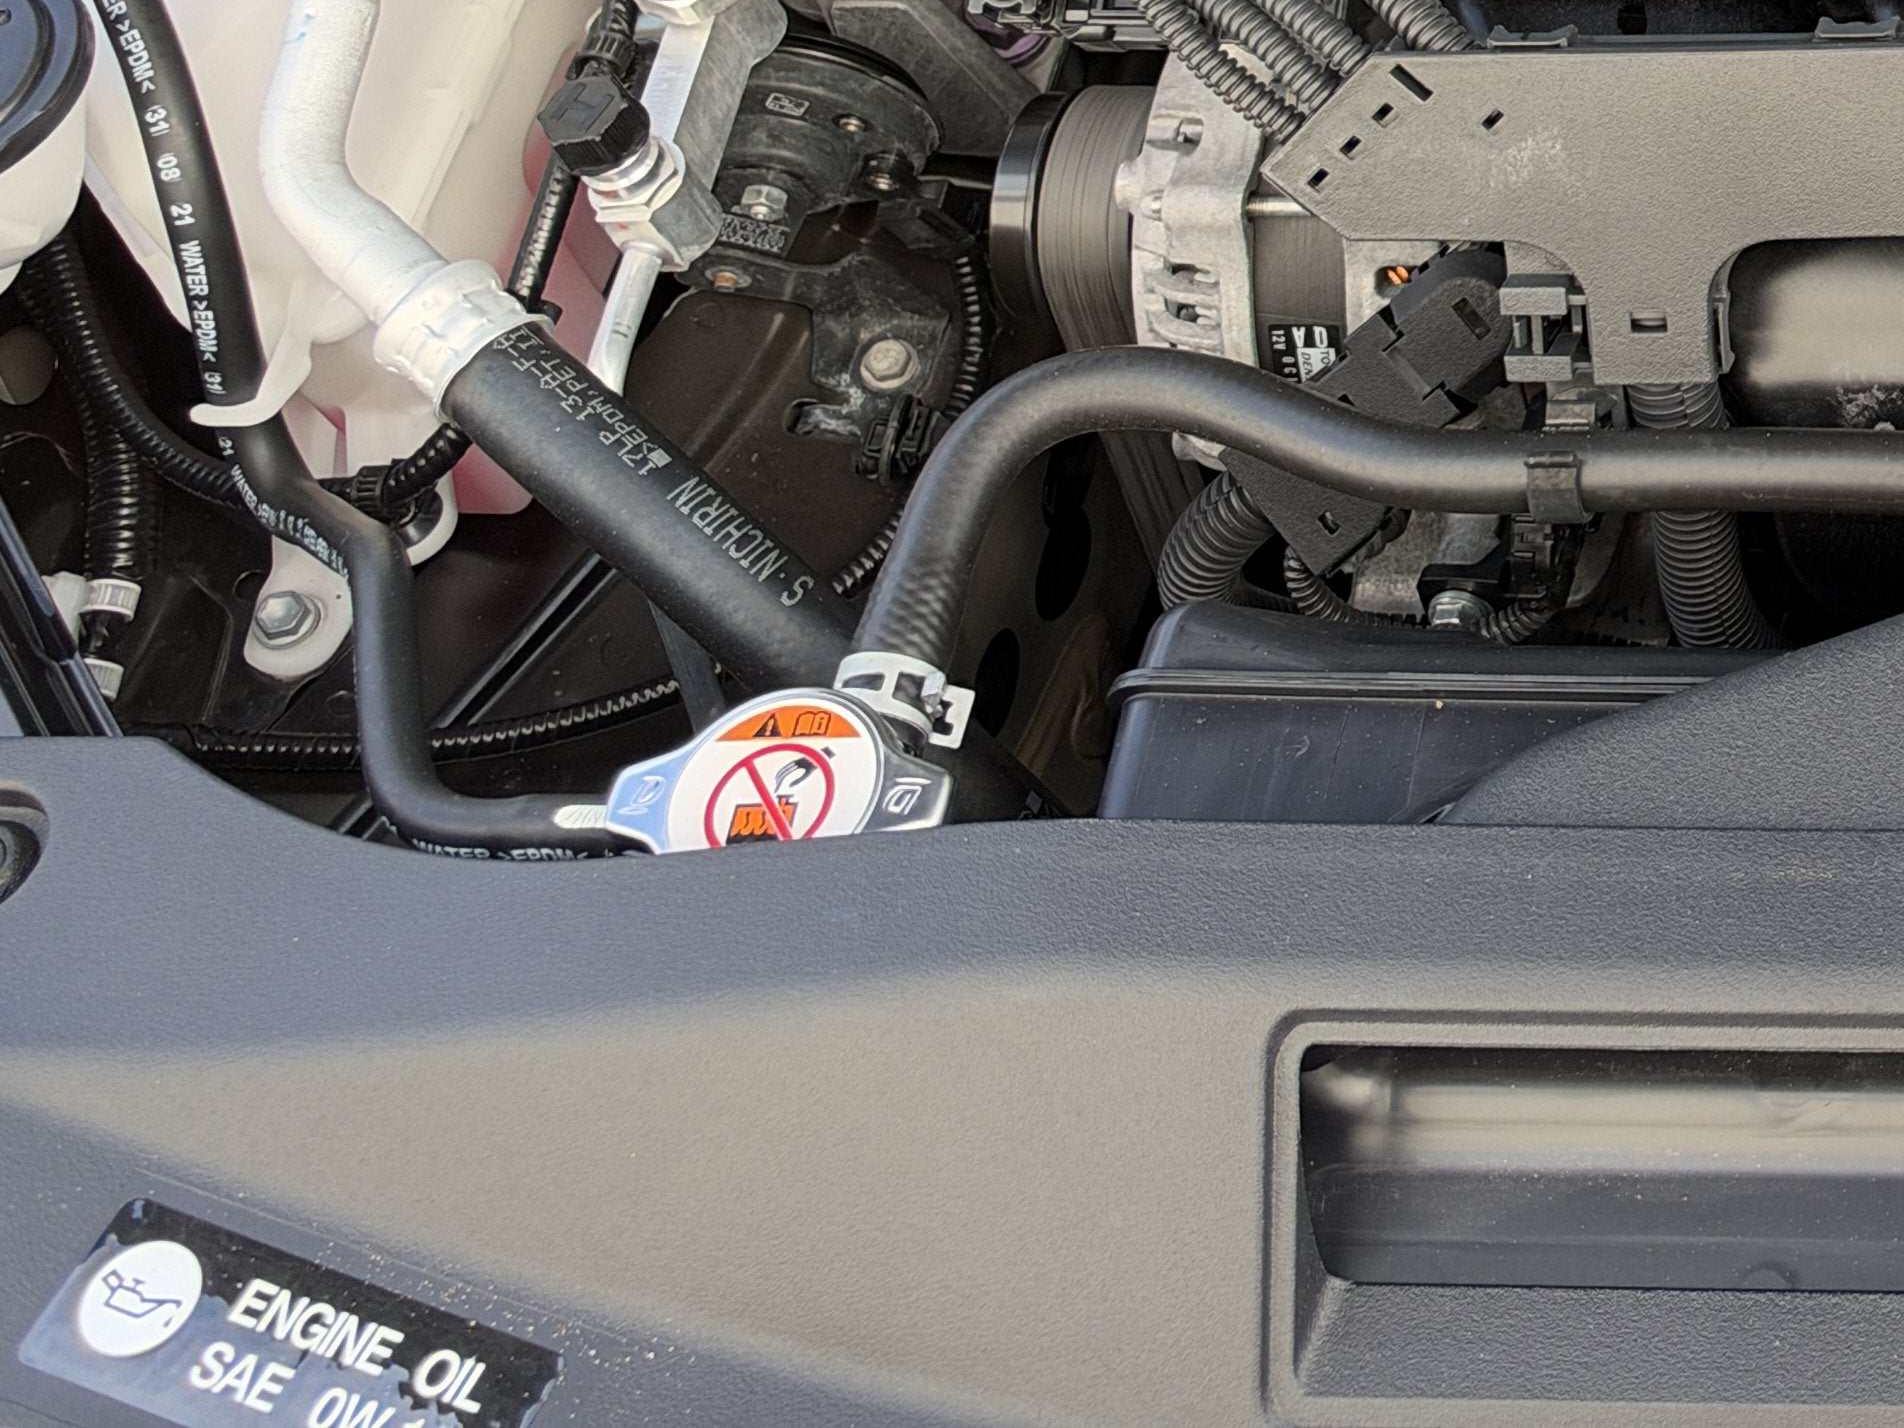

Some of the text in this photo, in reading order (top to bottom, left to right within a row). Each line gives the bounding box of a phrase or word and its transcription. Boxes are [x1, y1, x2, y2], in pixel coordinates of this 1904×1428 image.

[116, 19, 155, 94] >EPDM<
[179, 240, 209, 296] WATER
[192, 299, 217, 362] >EPDM<
[1271, 329, 1285, 349] 12V
[1291, 325, 1328, 347] QA
[230, 463, 259, 508] WATER
[227, 1278, 486, 1414] ENGINE OIL
[189, 1341, 296, 1413] SAE
